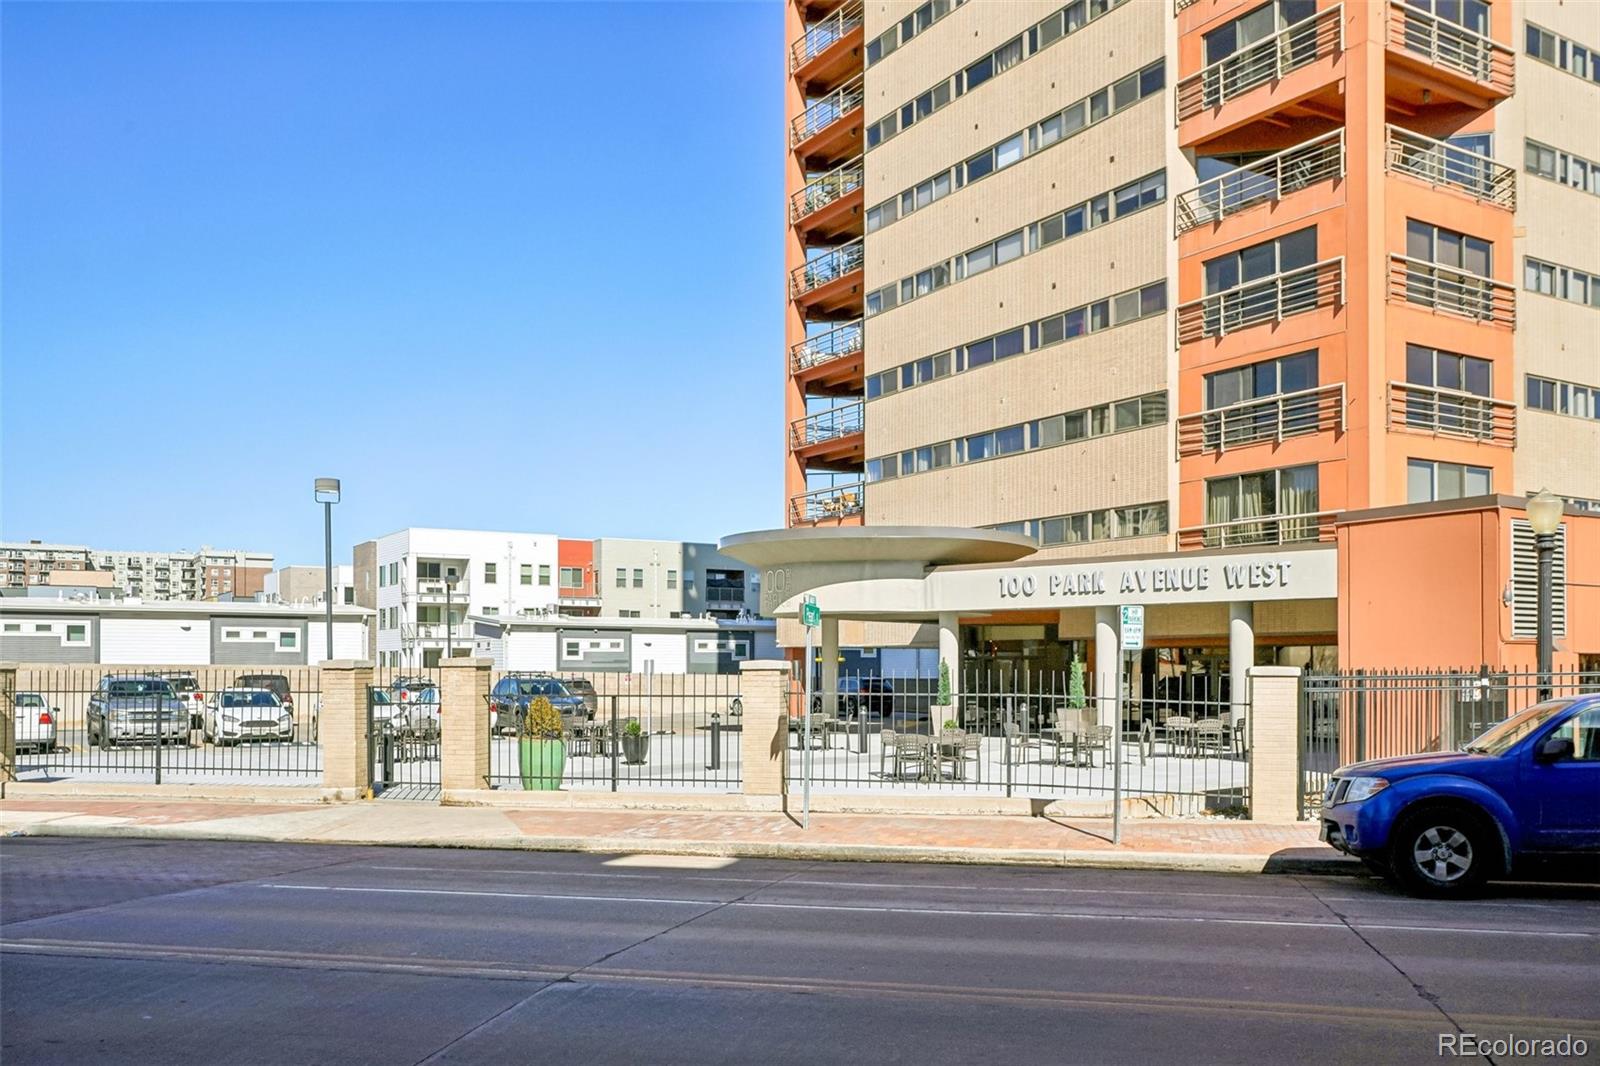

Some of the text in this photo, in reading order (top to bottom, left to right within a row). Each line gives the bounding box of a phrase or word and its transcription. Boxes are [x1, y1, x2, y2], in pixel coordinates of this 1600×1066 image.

[999, 560, 1292, 598] 100 PARK AVENUE WEST
